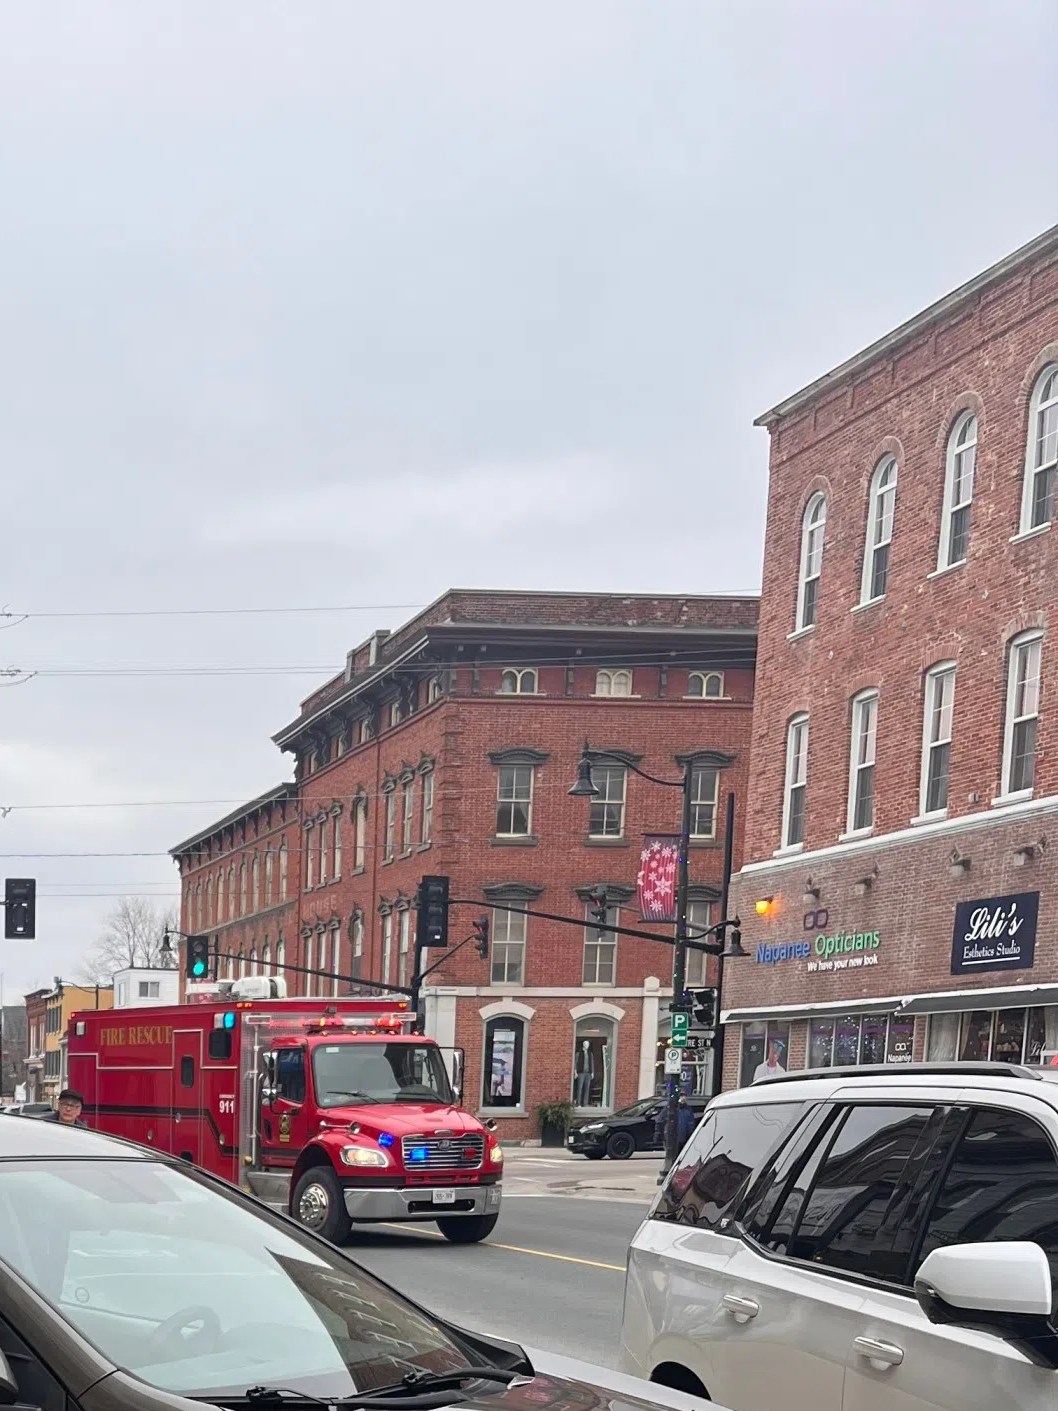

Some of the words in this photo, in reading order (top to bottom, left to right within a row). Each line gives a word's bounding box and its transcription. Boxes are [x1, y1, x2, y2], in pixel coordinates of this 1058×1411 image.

[964, 902, 1024, 941] Lili's
[756, 941, 811, 964] Napanee
[815, 929, 880, 959] Opticians
[963, 944, 994, 959] Esthetics
[996, 939, 1021, 956] Studio
[807, 961, 818, 972] We
[818, 960, 833, 971] have
[833, 959, 849, 971] your
[849, 958, 863, 968] new
[863, 953, 878, 966] look
[675, 1014, 685, 1028] P
[101, 1028, 127, 1045] FIRE
[129, 1026, 173, 1045] RESCUE
[706, 1039, 711, 1047] N
[219, 1100, 235, 1113] 911
